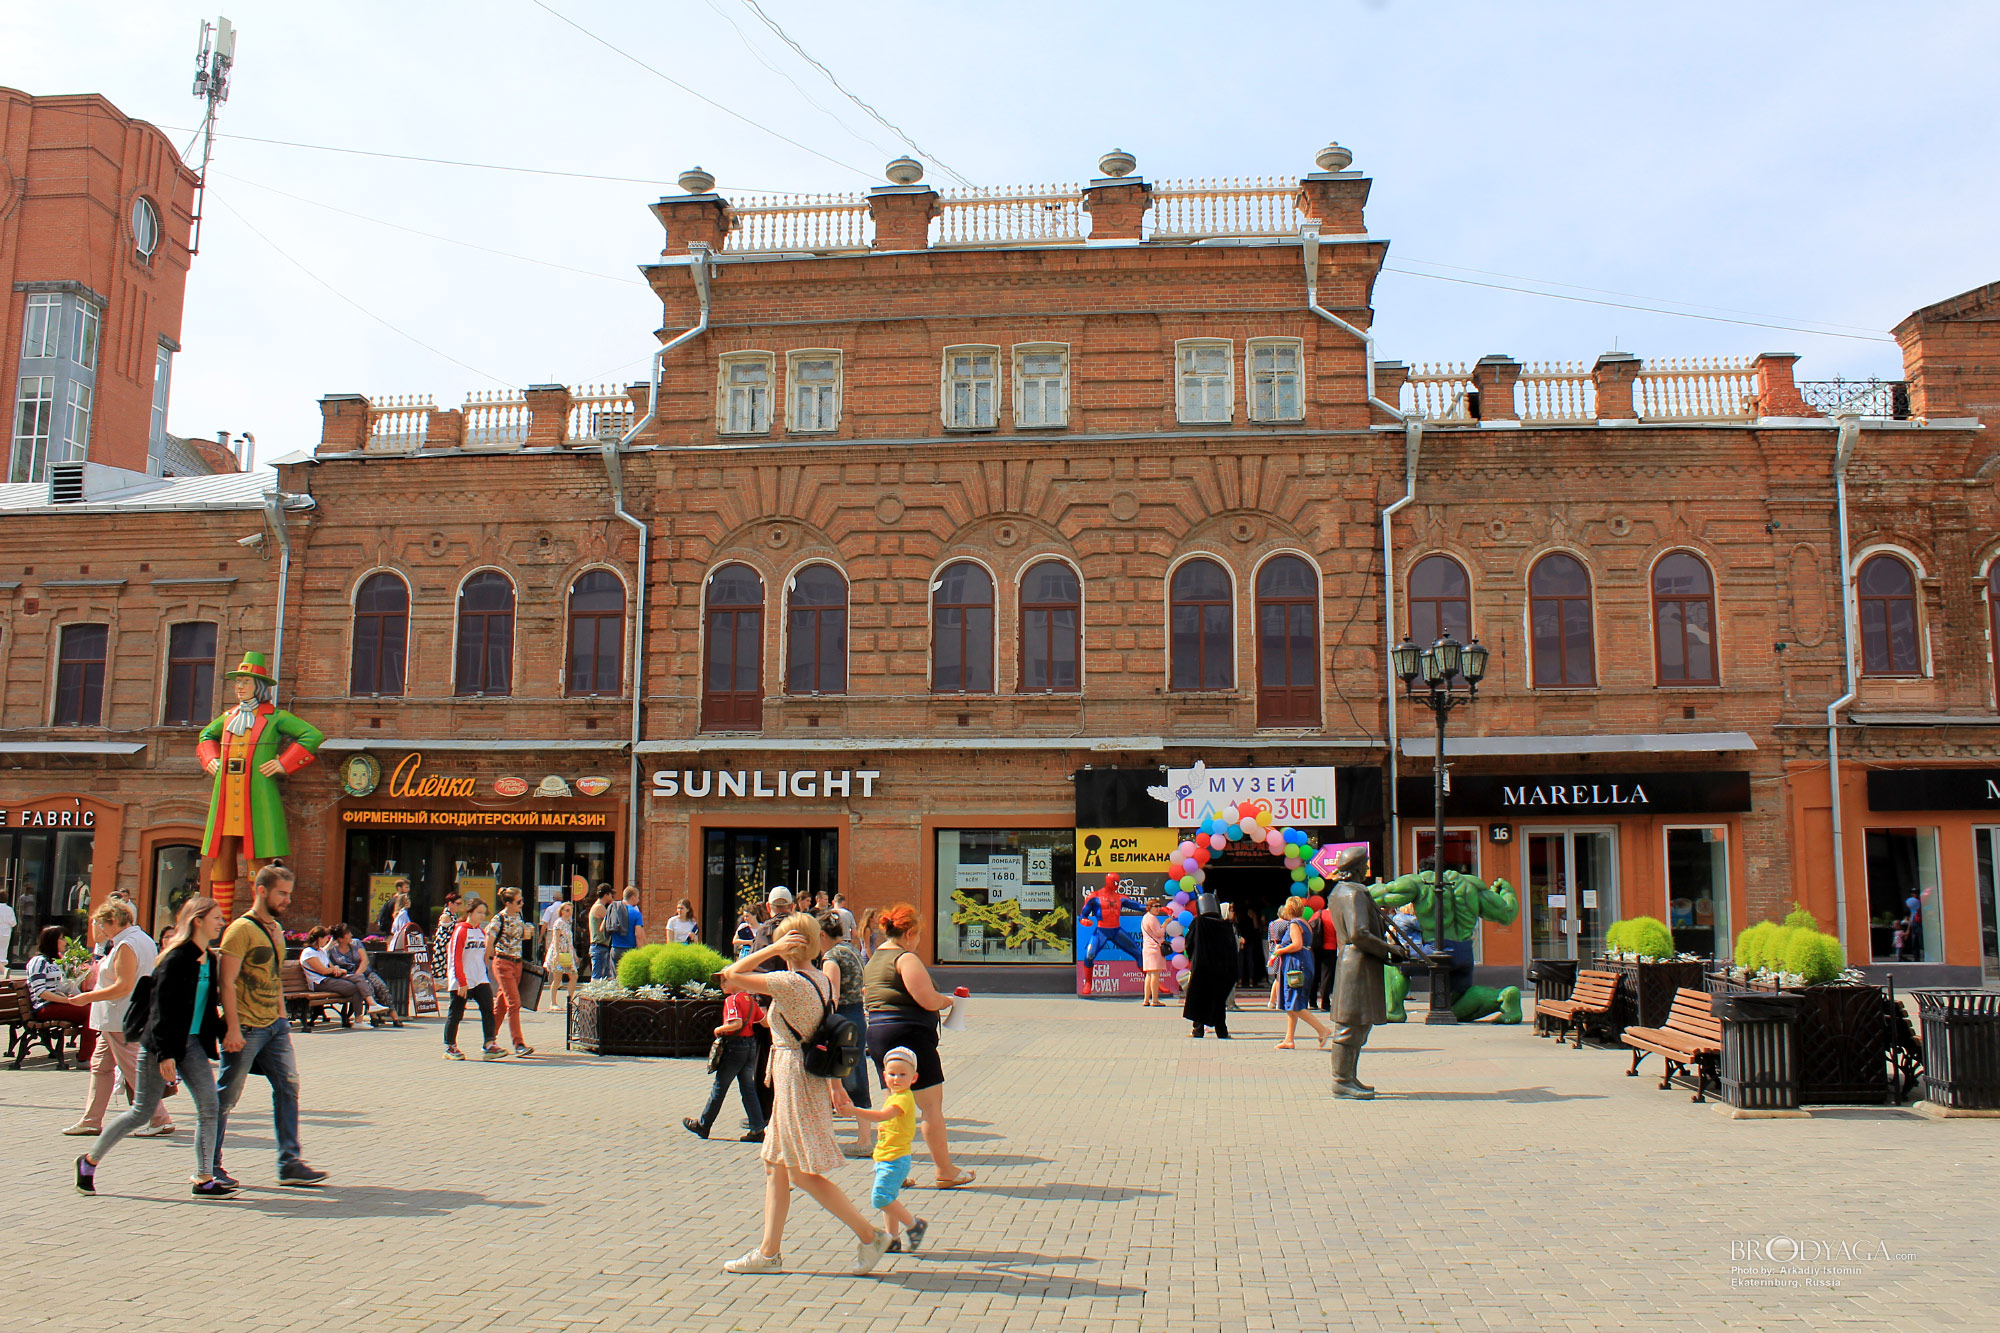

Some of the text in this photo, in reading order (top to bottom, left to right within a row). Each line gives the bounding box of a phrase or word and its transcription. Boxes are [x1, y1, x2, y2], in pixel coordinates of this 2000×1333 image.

[389, 752, 477, 797] Алёнка
[652, 770, 881, 798] SUNLIGHT
[1209, 774, 1294, 792] МУЗЕЙ
[1503, 783, 1649, 805] MARELLA
[1177, 795, 1326, 819] ИЛЗИЙ
[343, 810, 605, 826] ФИРМЕННЫЙ КОНДИТЕРСКИЙ МАГАЗИН
[1493, 827, 1508, 840] 16
[1110, 839, 1137, 849] ДОМ
[1110, 853, 1171, 862] ВЕЛИКАНА
[992, 872, 1015, 881] 1680
[1115, 881, 1148, 896] ОБЕГ
[970, 939, 981, 948] 80
[1083, 978, 1119, 992] СУДУ!
